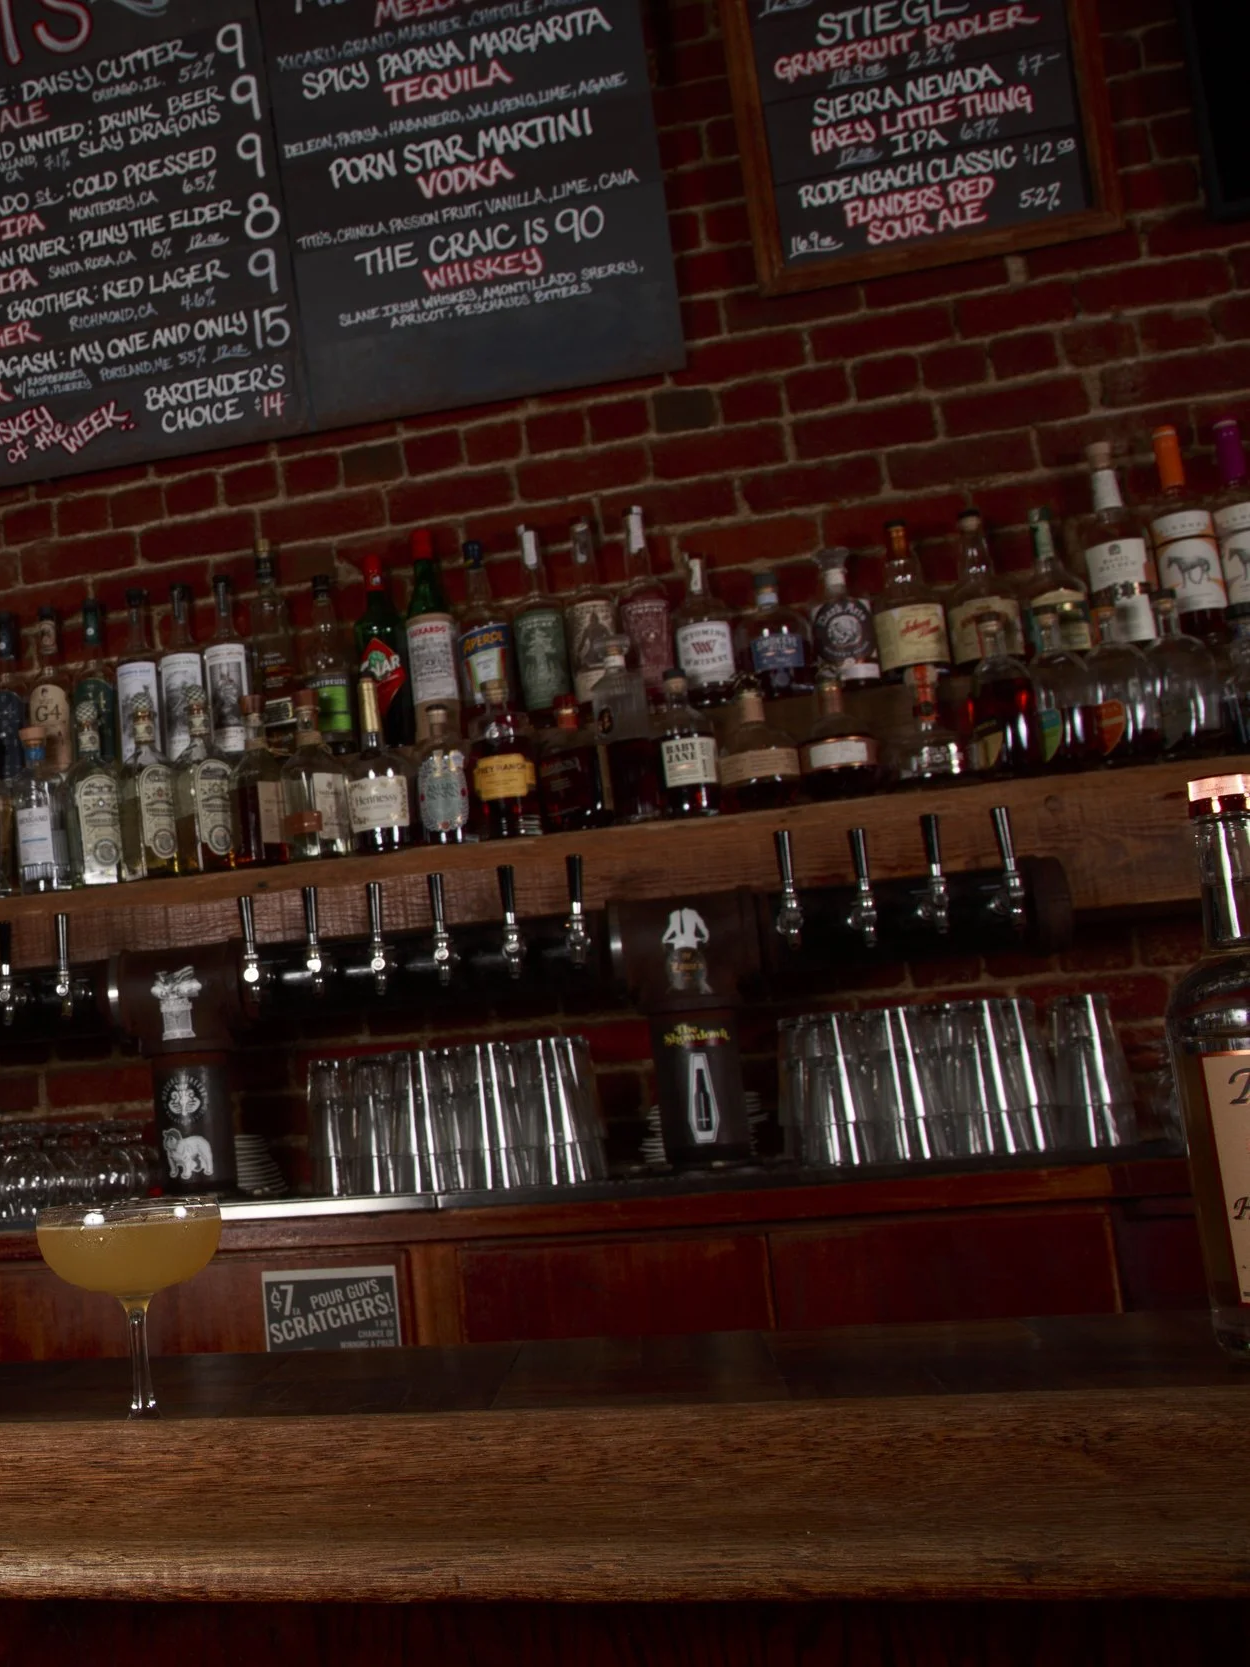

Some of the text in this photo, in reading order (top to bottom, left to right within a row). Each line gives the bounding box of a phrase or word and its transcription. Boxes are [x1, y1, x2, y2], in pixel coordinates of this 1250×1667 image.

[774, 4, 1041, 83] GRAPEFRUIT RADLER
[815, 0, 970, 46] STIEGL
[21, 66, 95, 104] DAISY
[96, 38, 199, 83] CUTTER
[216, 22, 246, 70] 9
[302, 58, 371, 101] SPICY
[378, 40, 467, 83] PAPAYA
[469, 7, 614, 63] MARGARITA
[98, 101, 161, 136] DRINK
[166, 85, 227, 117] BEER
[230, 74, 263, 122] 9
[383, 55, 514, 107] TEQUILA
[811, 62, 1005, 127] SIERRA NEVADA
[78, 104, 223, 160] SLAY DRAGONS
[810, 85, 1035, 156] HAZY LITTLE THING
[889, 128, 949, 158] IPA
[121, 145, 217, 187] PRESSED
[236, 131, 266, 179] 9
[327, 149, 398, 188] PORN
[403, 134, 477, 175] STAR
[476, 107, 595, 160] MARTINI
[416, 157, 517, 200] VODKA
[797, 145, 1018, 208] RODENBACH CLASSIC
[843, 175, 996, 229] FLANDERS RED
[0, 211, 47, 241] IPA
[78, 219, 129, 254] PLINY
[130, 209, 166, 240] THE
[170, 199, 242, 230] ELDER
[245, 192, 281, 240] 8
[353, 204, 606, 279] THE CRAIC IS 90
[865, 200, 989, 247] SOUR ALE
[102, 276, 145, 303] RED
[148, 259, 231, 295] LAGER
[247, 248, 279, 295] 9
[421, 246, 545, 293] WHISKEY
[70, 304, 292, 366] MY ONE AND ONLY 15
[144, 363, 286, 412] BARTENDER'S
[161, 398, 245, 434] CHOICE
[463, 631, 504, 653] APEROL
[34, 703, 63, 723] G4
[666, 742, 697, 754] BABY
[667, 751, 696, 764] JANE
[269, 1292, 396, 1345] SCRATCHERS!
[309, 1278, 381, 1311] POUR GUYS
